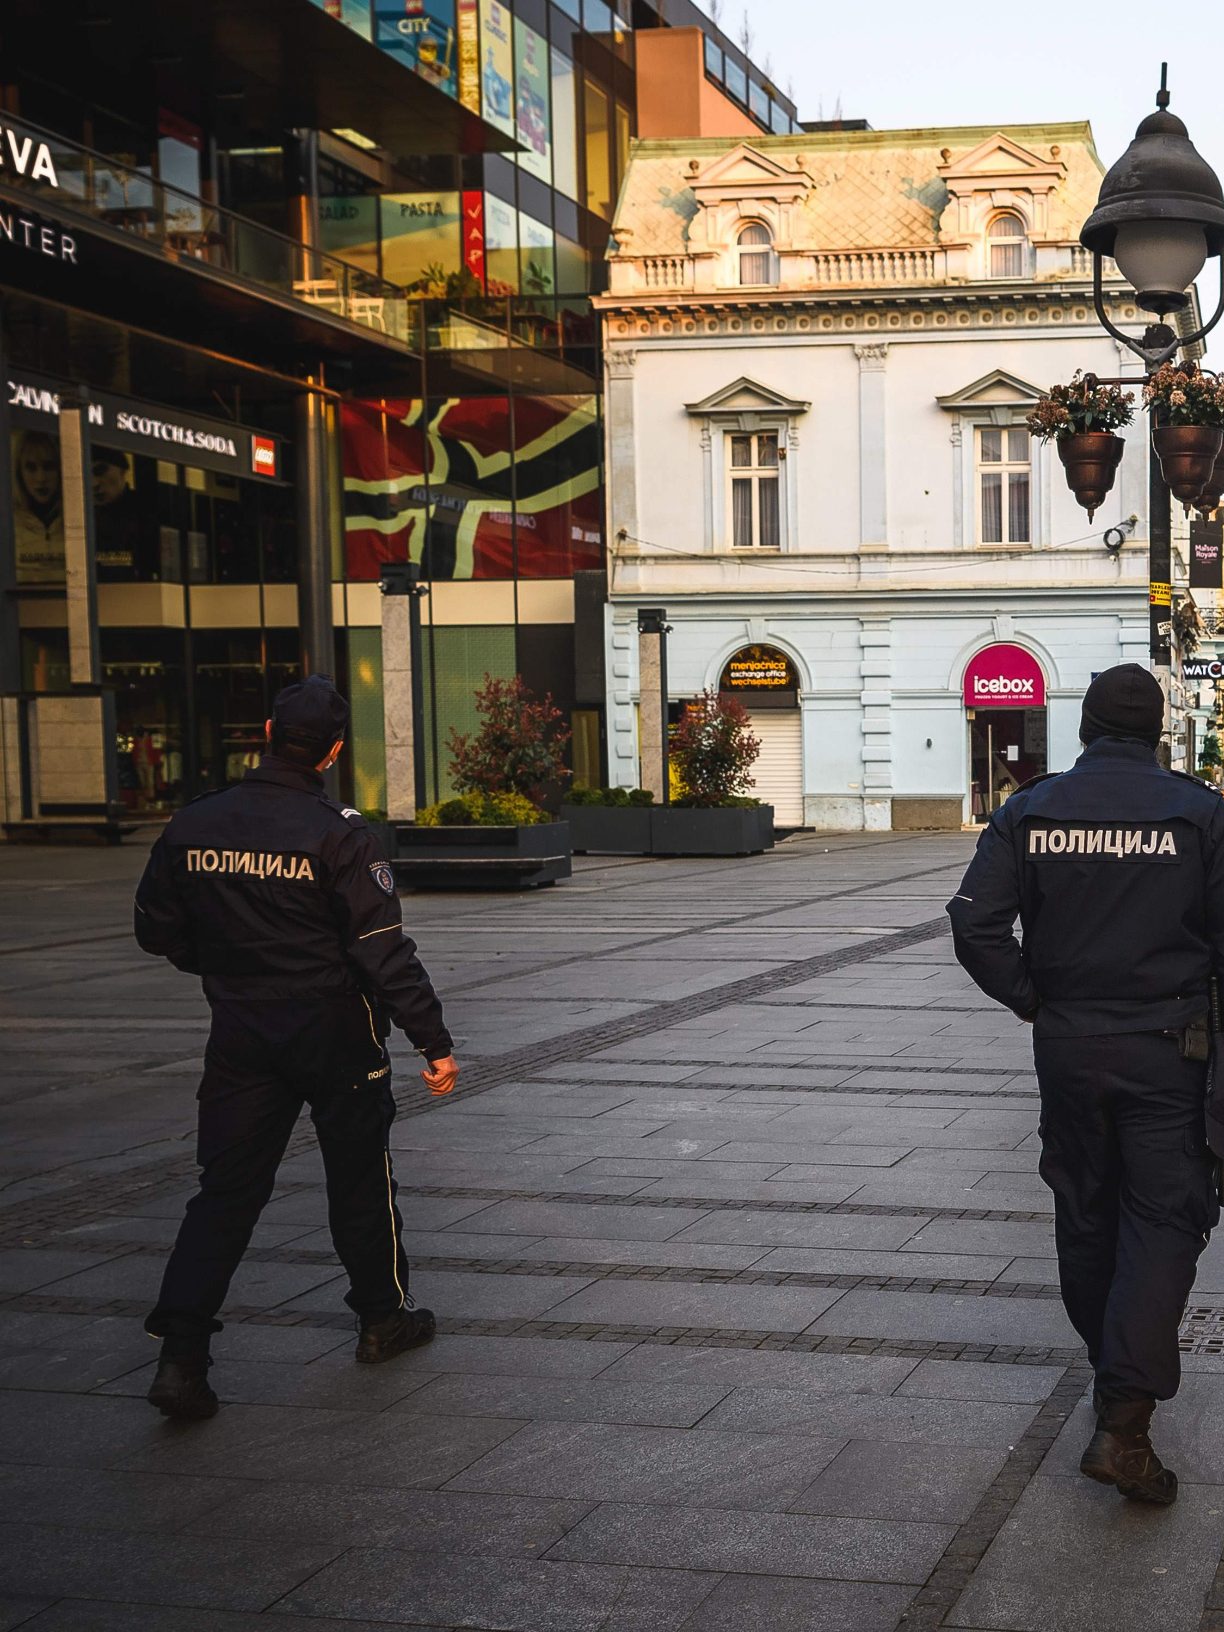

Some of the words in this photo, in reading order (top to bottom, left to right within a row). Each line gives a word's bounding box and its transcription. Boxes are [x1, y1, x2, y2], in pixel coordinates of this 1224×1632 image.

[397, 17, 431, 33] CITY
[0, 126, 58, 187] VA
[400, 202, 444, 218] PASTA
[467, 204, 483, 278] VAP
[117, 412, 237, 457] SCOTCH&SODA
[974, 675, 1034, 693] icebox
[1029, 829, 1177, 858] ПОЛИЦИЈА
[187, 850, 314, 881] ПОЛИЦИЈА
